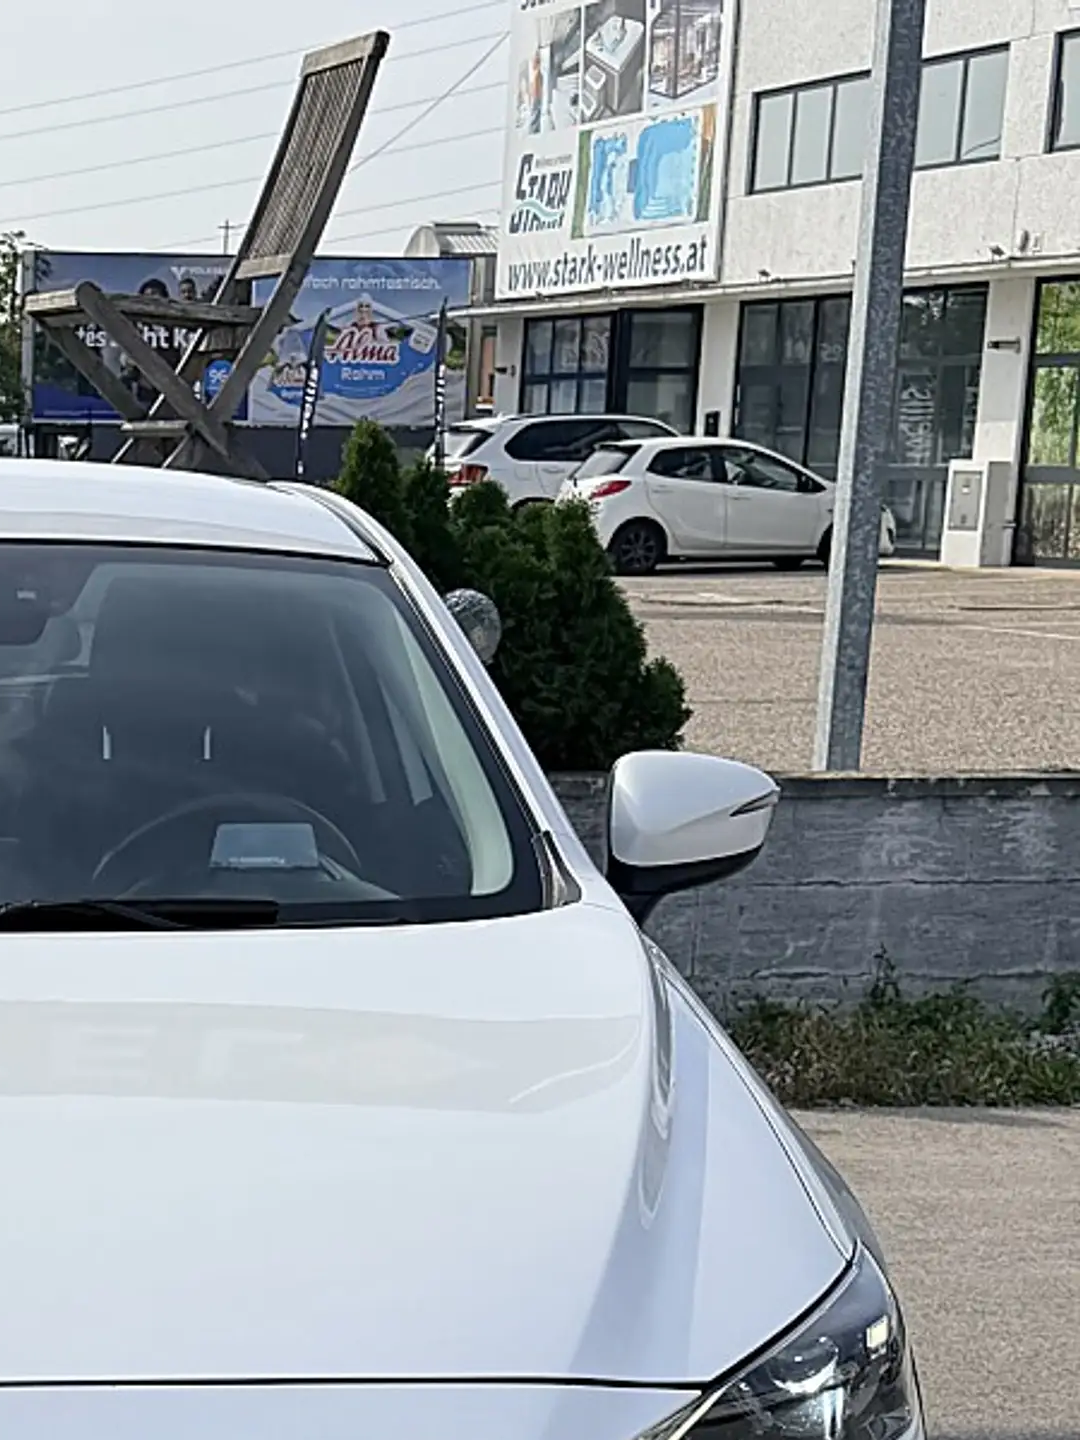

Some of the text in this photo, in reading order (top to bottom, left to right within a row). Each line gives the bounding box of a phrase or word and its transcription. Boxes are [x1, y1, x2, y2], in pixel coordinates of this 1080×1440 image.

[508, 234, 708, 292] www.stark-wellness.at
[325, 329, 398, 362] Alma
[340, 367, 386, 381] Rahm
